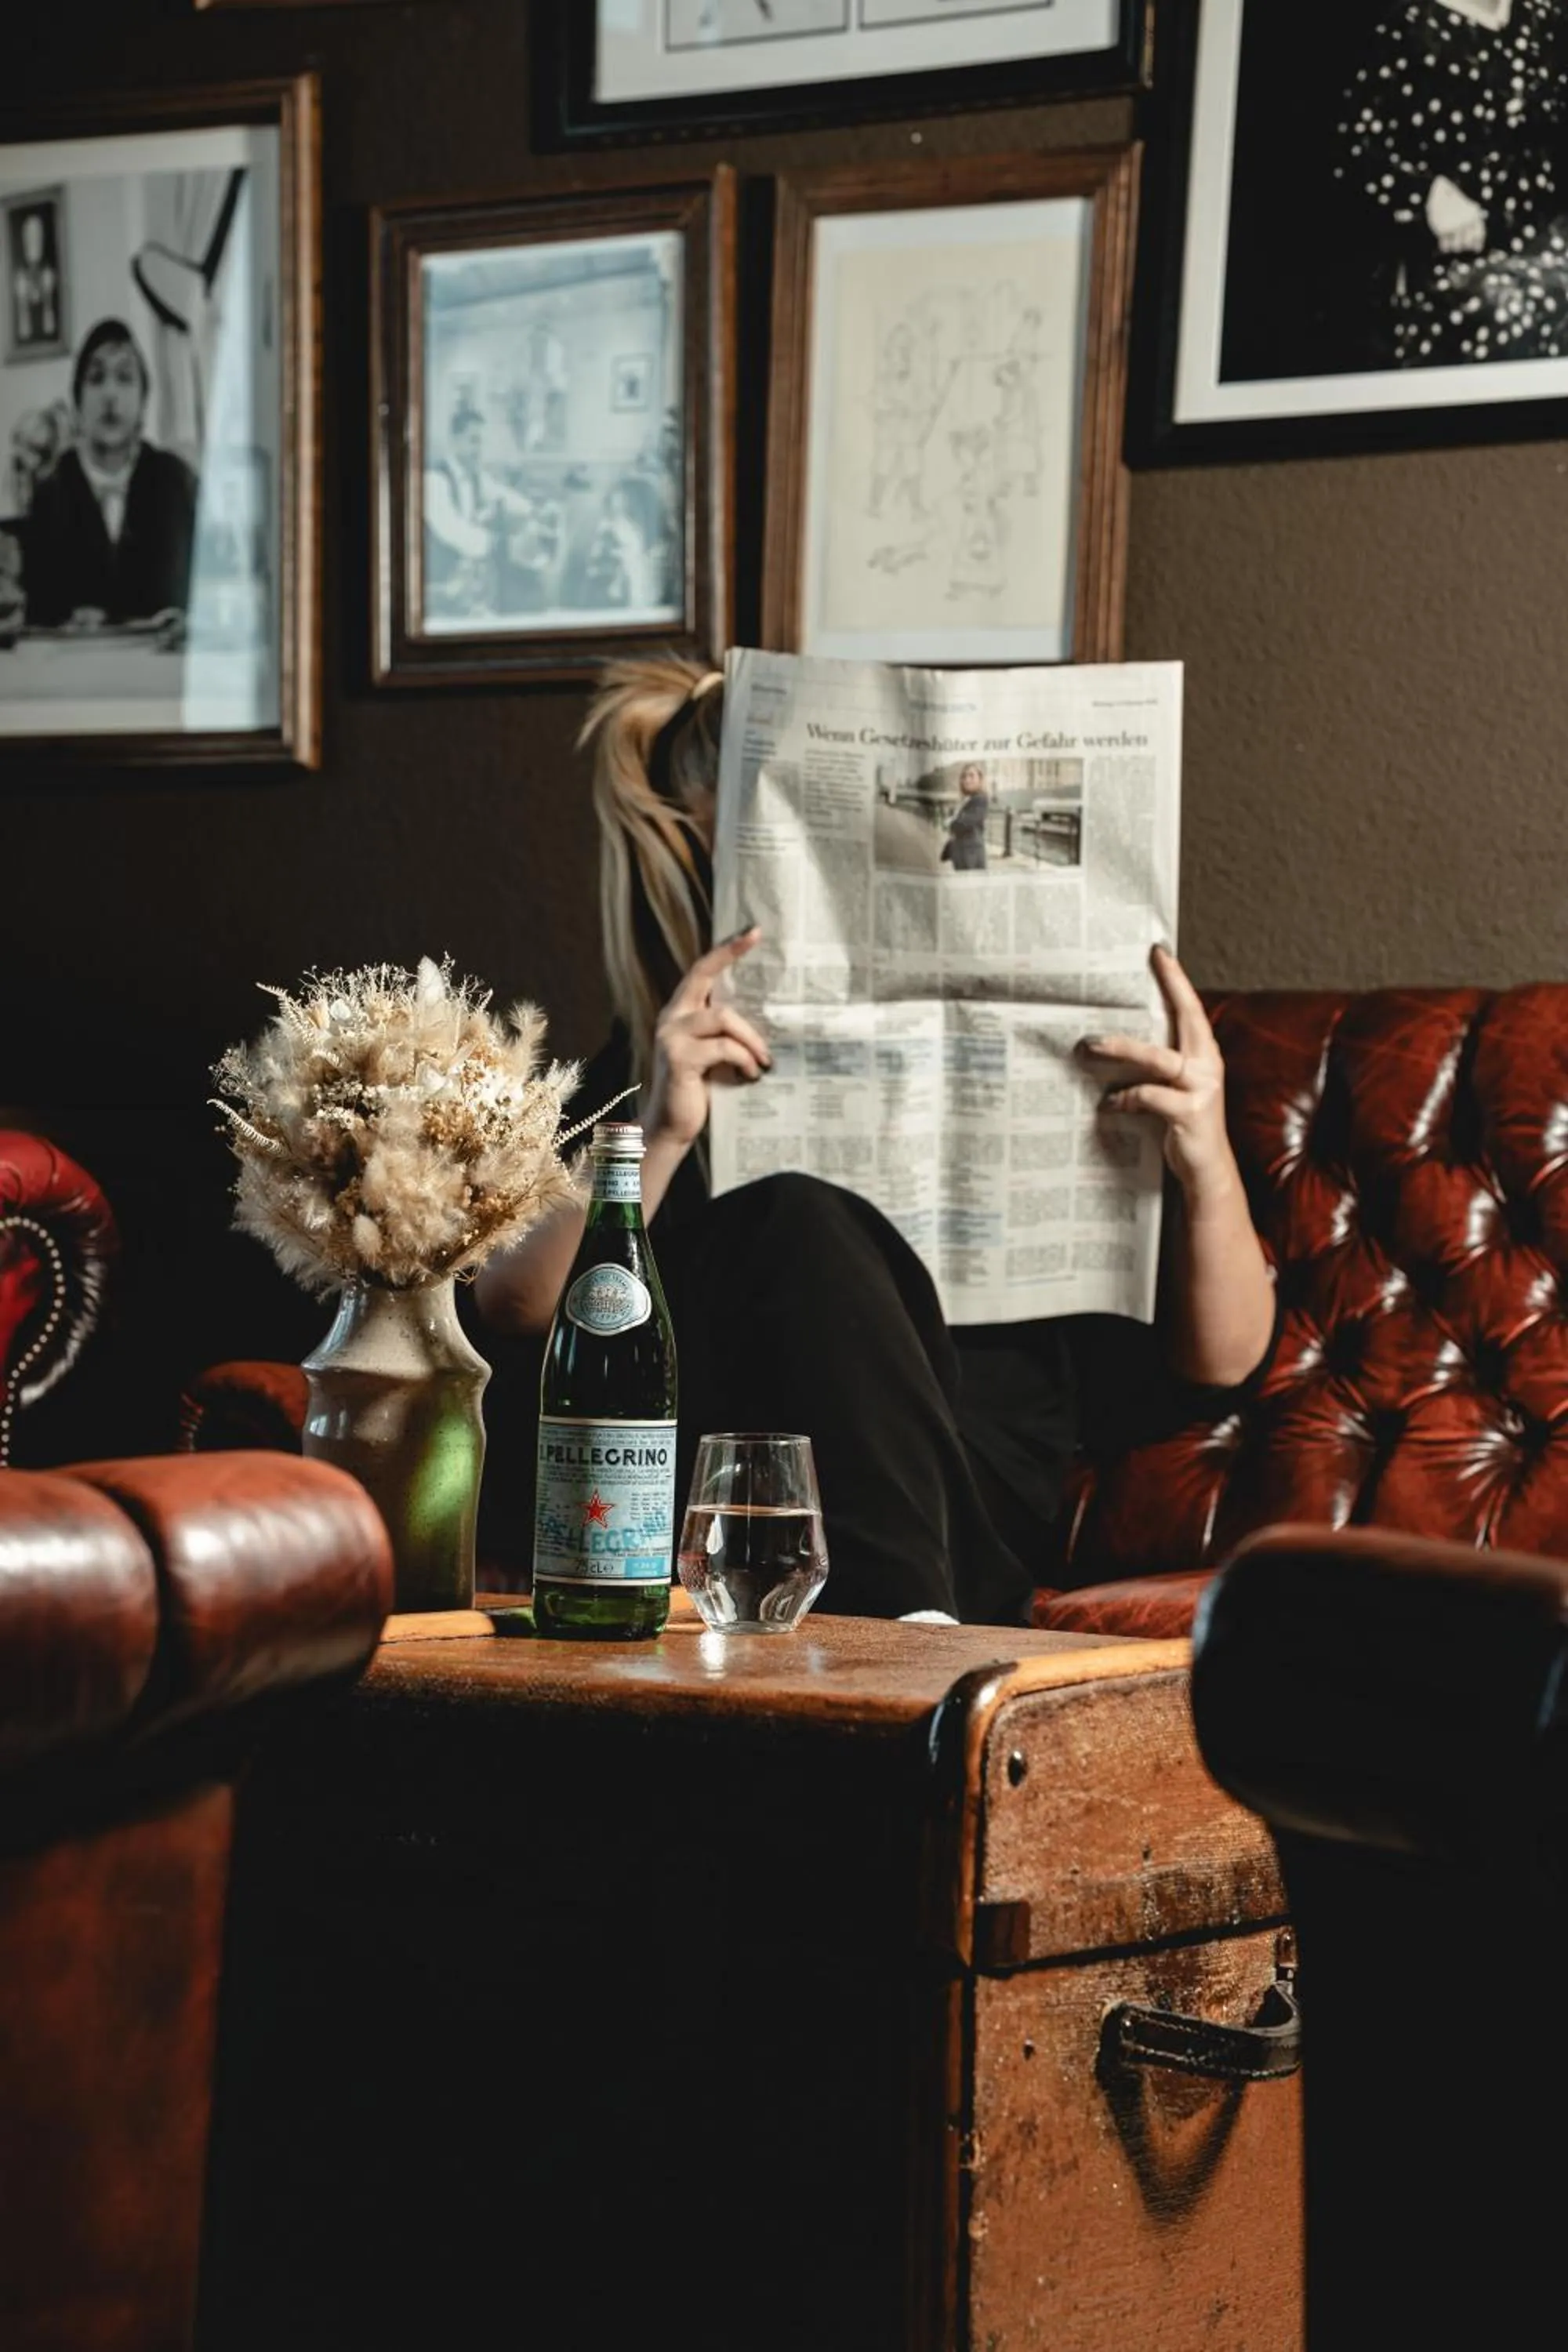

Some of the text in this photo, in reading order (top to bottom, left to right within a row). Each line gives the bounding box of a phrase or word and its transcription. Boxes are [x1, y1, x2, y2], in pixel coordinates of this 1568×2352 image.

[983, 738, 1011, 751] zur
[1017, 731, 1077, 749] Gefahr
[1083, 730, 1149, 748] werden
